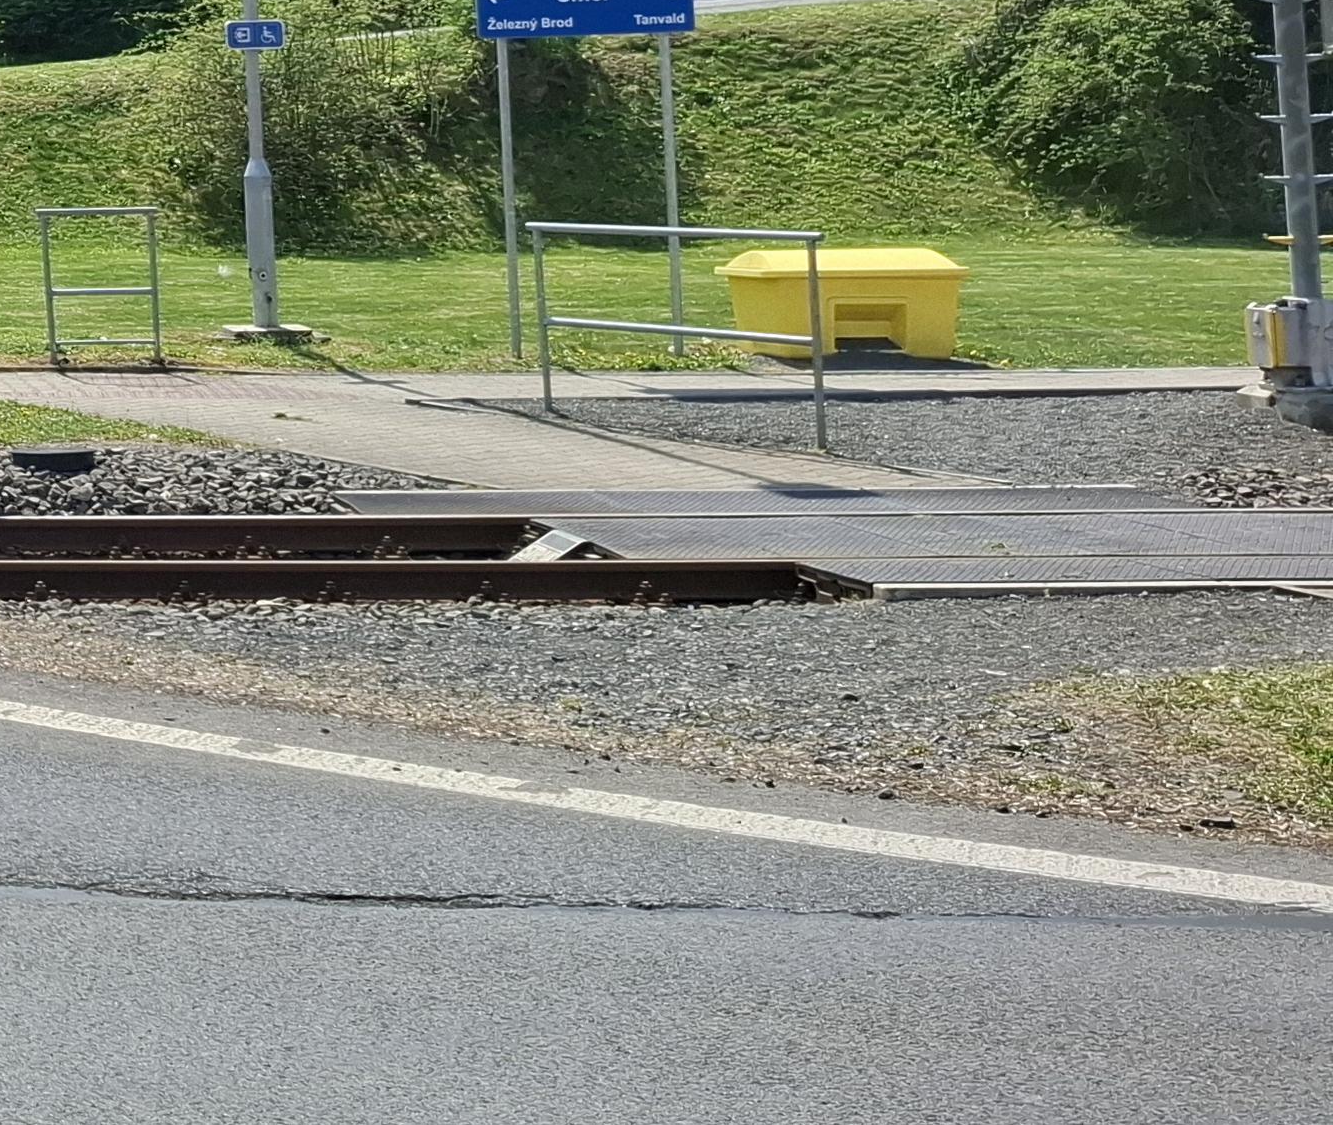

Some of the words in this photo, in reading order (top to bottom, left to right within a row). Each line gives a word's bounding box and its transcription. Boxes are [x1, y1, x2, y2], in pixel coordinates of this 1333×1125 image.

[487, 16, 537, 32] Železný
[541, 17, 574, 29] Brod
[634, 13, 685, 25] Tanvald
